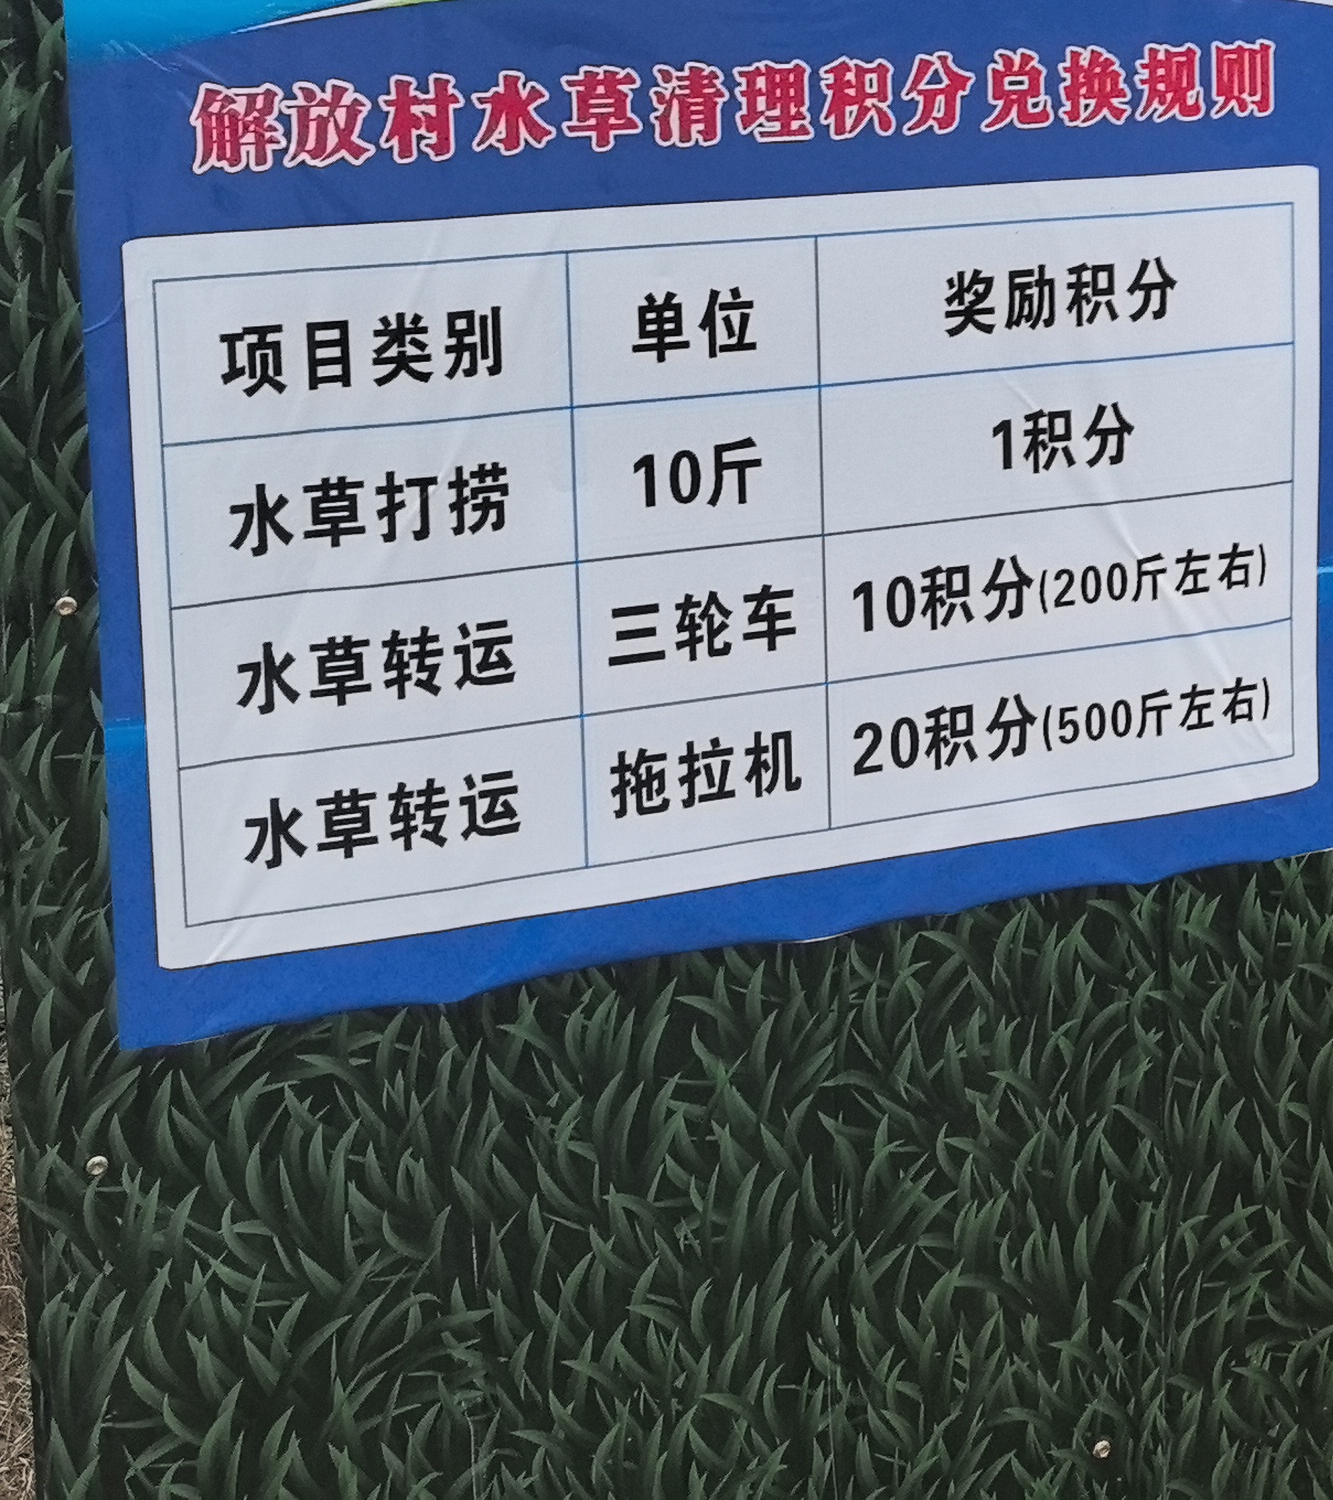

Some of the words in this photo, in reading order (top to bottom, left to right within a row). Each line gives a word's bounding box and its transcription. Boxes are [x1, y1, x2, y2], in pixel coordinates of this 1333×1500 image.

[192, 40, 1276, 173] 解放村水草清理积分兑换规则
[631, 286, 757, 364] 单位
[944, 256, 1177, 338] 奖励积分
[219, 305, 503, 398] 项目类别
[633, 436, 762, 508] 10斤
[992, 402, 1135, 474] 1积分
[229, 461, 511, 556] 水草打捞
[236, 619, 516, 715] 水草转运
[608, 584, 797, 667] 三轮车
[610, 730, 802, 819] 拖拉机
[244, 770, 521, 870] 水草转运
